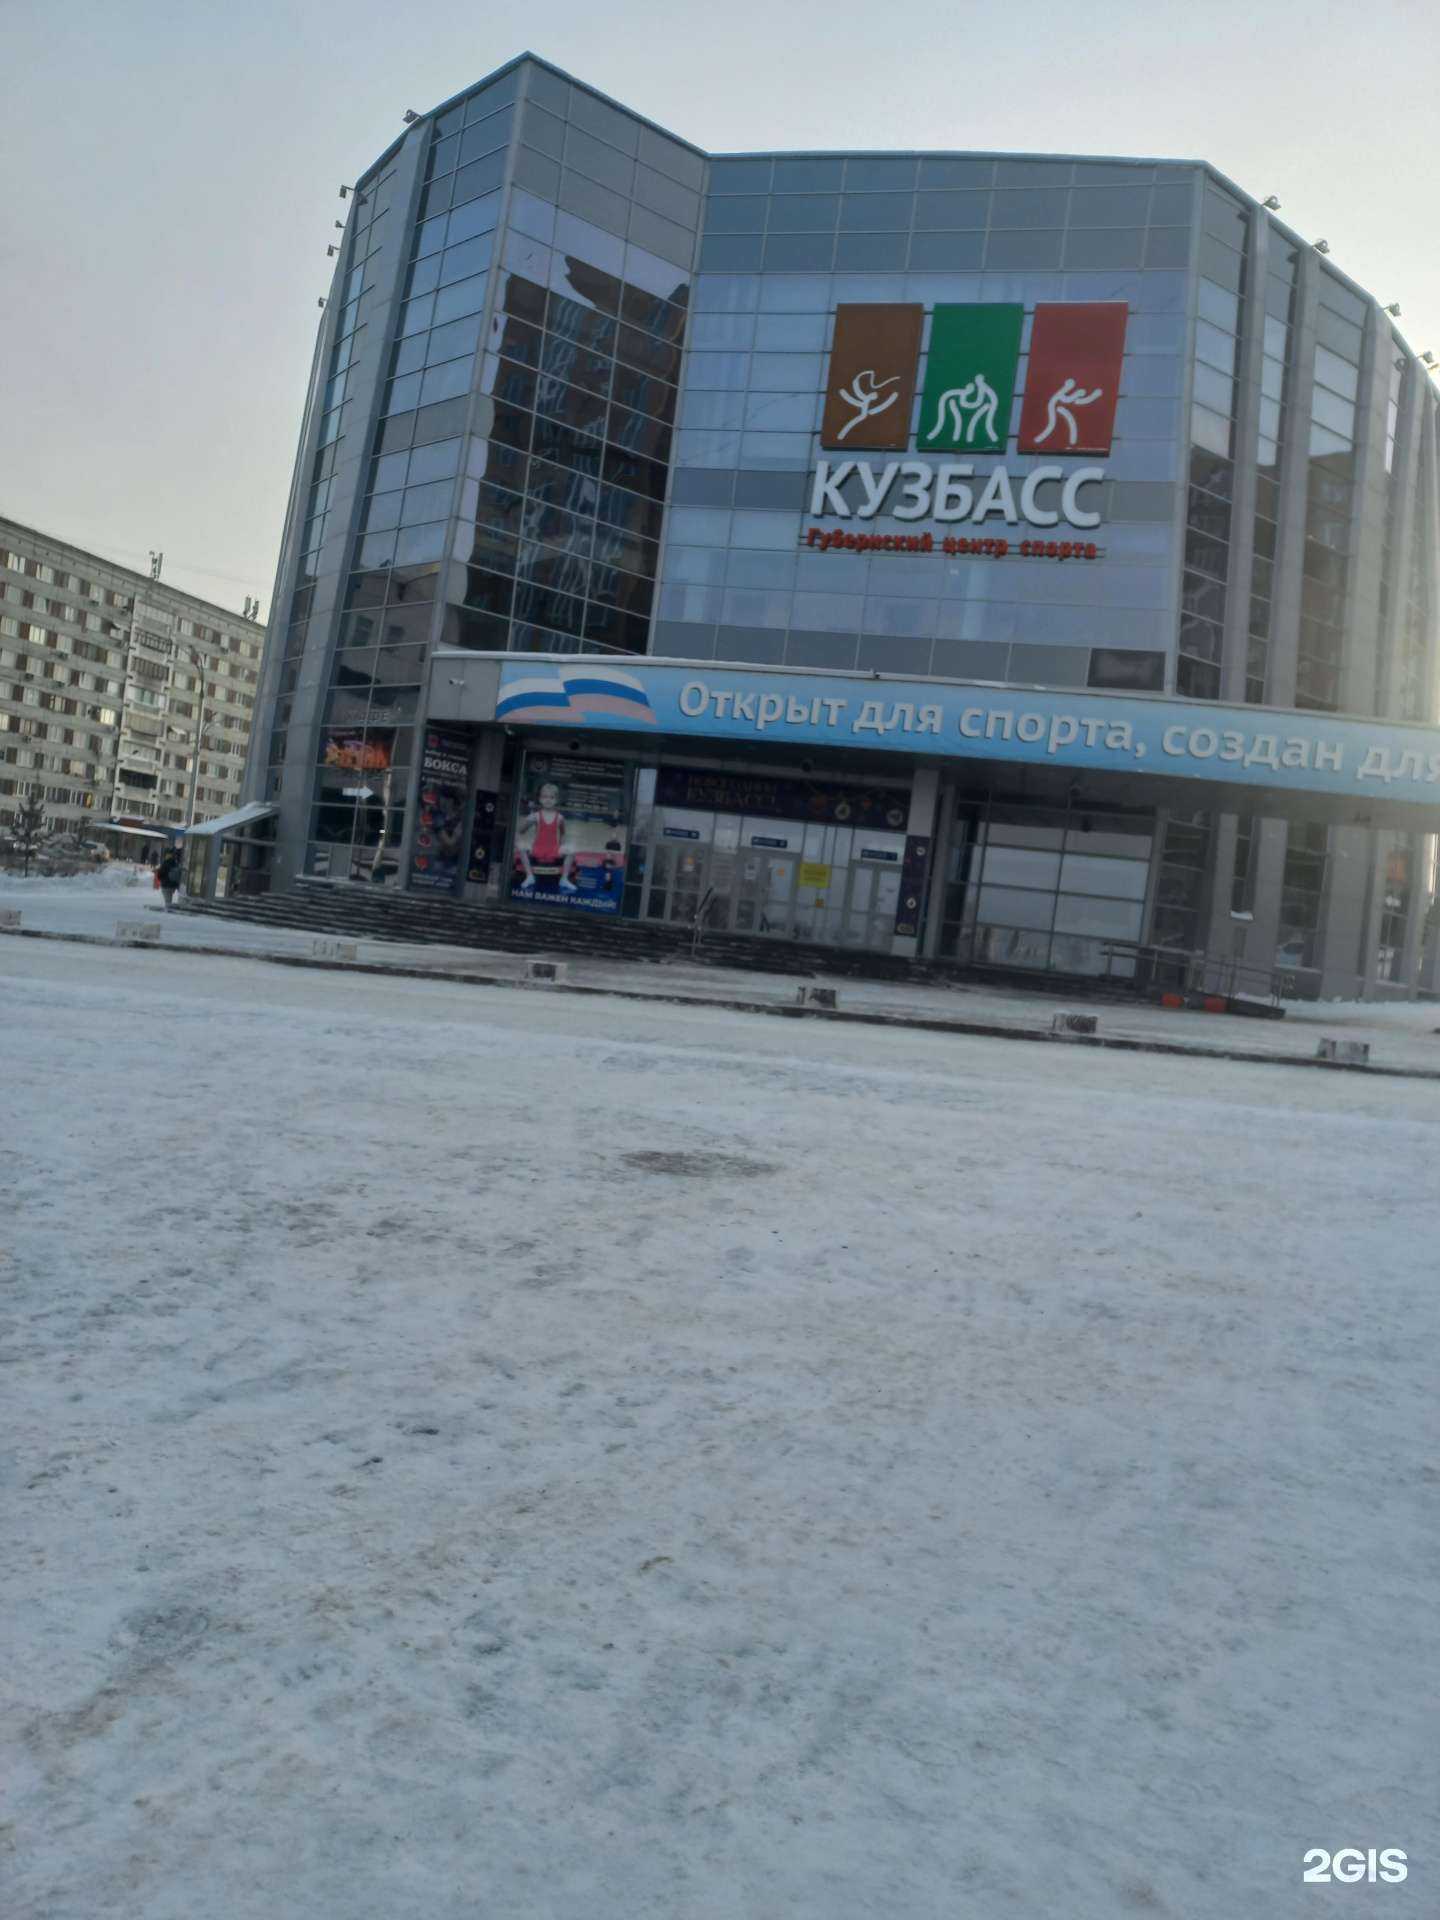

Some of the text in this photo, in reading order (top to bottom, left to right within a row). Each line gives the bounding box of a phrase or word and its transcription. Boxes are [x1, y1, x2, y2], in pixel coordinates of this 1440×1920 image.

[810, 460, 1105, 528] КУЗБАСС
[806, 527, 1097, 561] Губернский центр спорта
[678, 681, 848, 730] Открыт
[852, 700, 944, 736] для
[958, 706, 1148, 758] спорта,
[1161, 723, 1344, 772] создан
[423, 756, 468, 776] БОКСА
